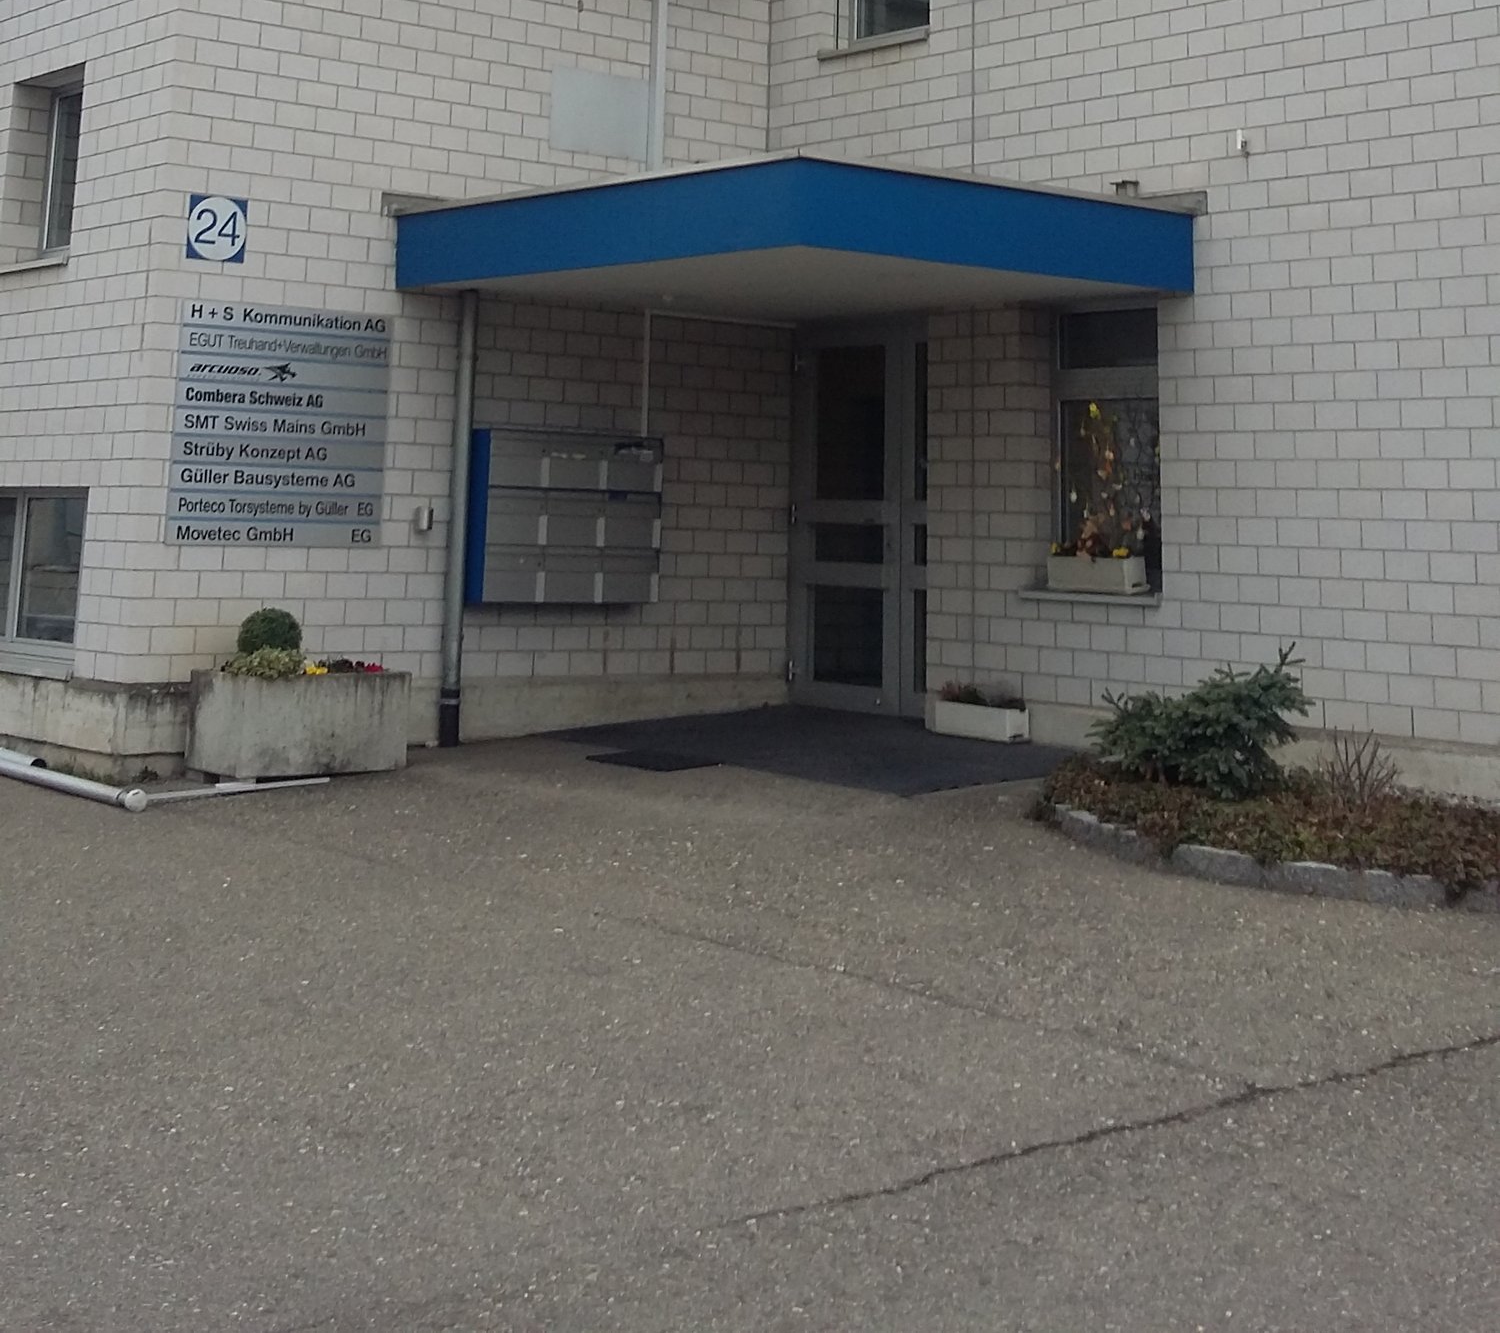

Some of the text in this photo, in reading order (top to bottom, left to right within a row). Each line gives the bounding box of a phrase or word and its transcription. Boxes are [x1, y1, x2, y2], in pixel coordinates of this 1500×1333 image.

[194, 209, 240, 247] 24
[191, 304, 203, 318] H
[222, 306, 234, 321] S
[243, 308, 361, 332] Kommunikation
[364, 318, 386, 333] AG
[189, 332, 224, 348] EGUT
[354, 346, 388, 360] GmbH
[185, 387, 324, 408] Combera Schweiz AG
[184, 414, 366, 437] SMT Swiss Mains GmbH
[183, 441, 327, 462] Strüby Konzept AG
[180, 469, 356, 488] Güller Bausysteme AG
[178, 497, 373, 518] Porteco Torsysteme by Güller EG
[176, 526, 371, 543] Movetec GmbH EG
